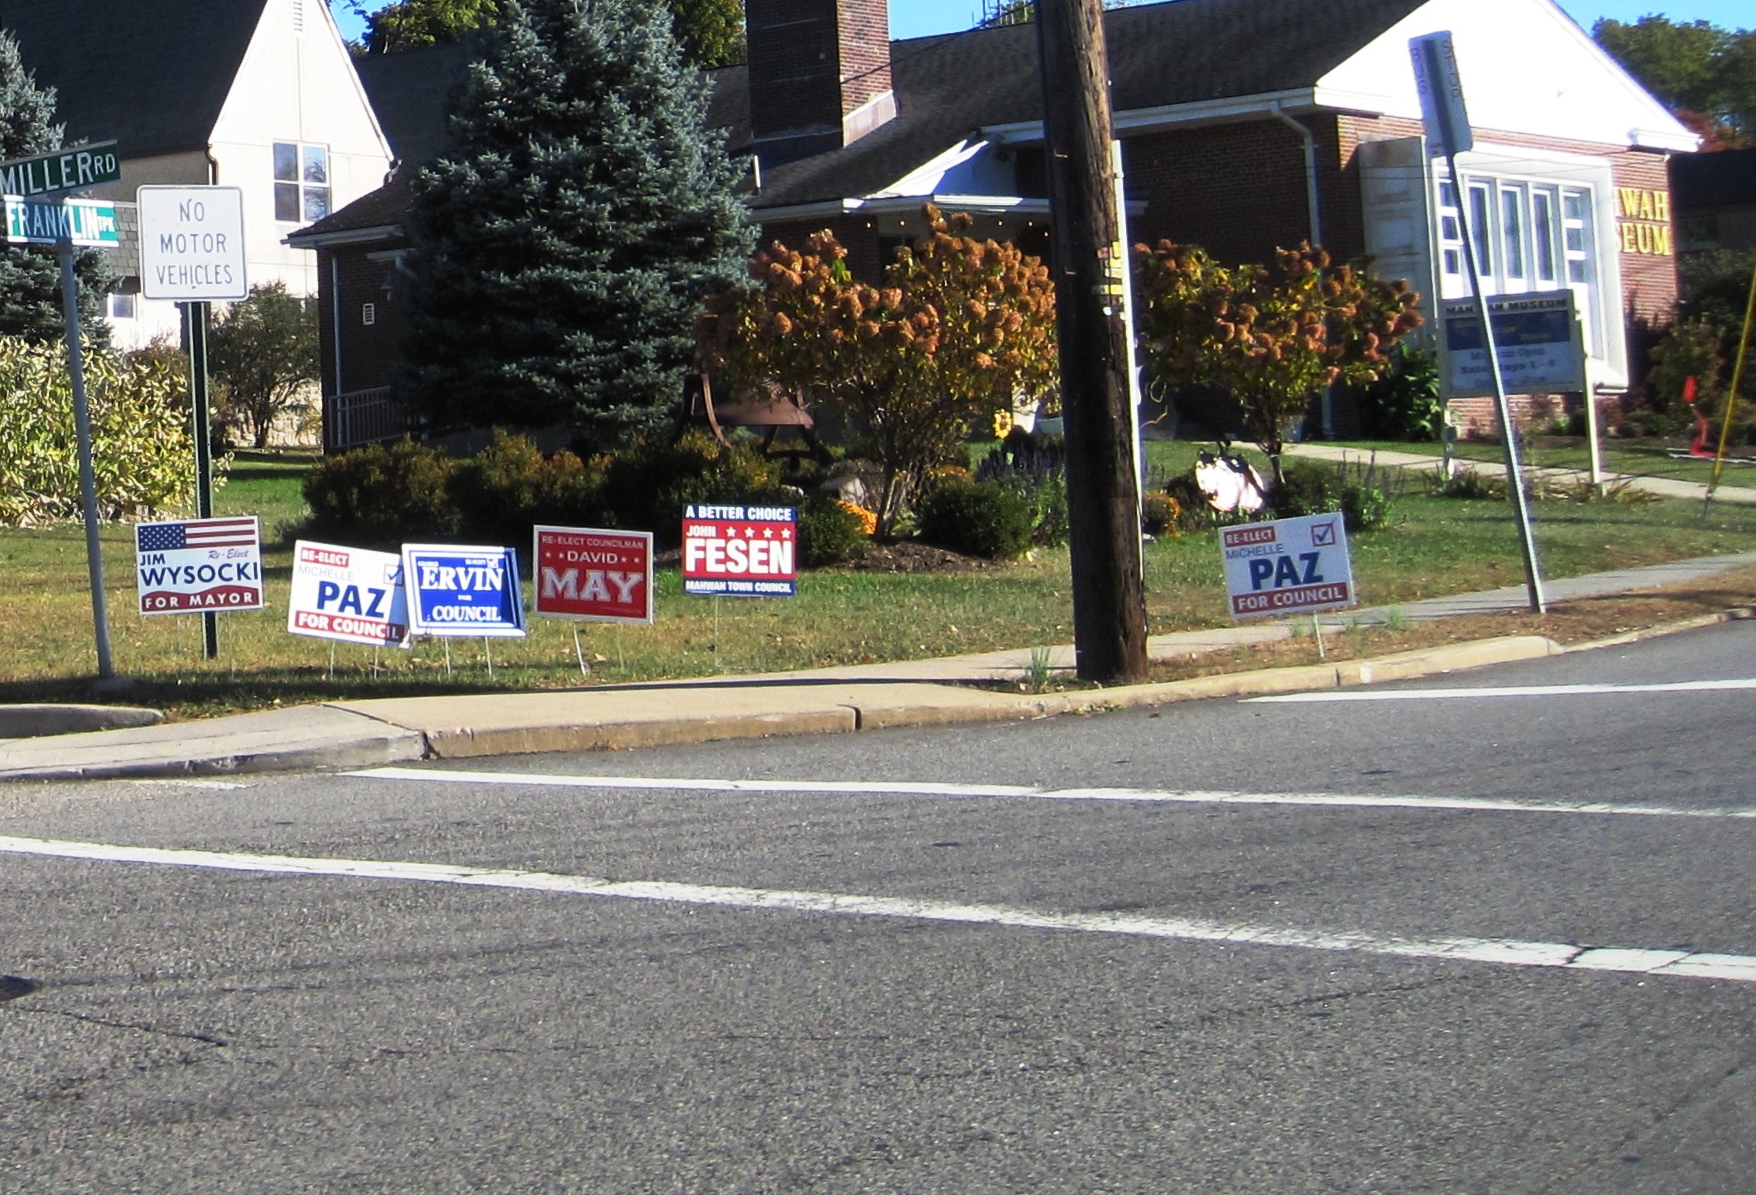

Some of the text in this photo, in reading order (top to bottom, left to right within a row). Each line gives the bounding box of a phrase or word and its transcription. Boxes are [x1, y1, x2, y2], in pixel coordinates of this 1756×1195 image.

[1443, 40, 1460, 99] STOP
[94, 154, 116, 175] RD
[179, 199, 204, 221] NO
[5, 202, 115, 239] FRANKLIN TPK
[160, 233, 226, 253] MOTOR
[156, 265, 232, 285] VEHICLES
[1446, 299, 1566, 314] MAHAH MUSEUM
[686, 505, 792, 521] A BETTER CHOICE
[686, 525, 716, 537] JOHN
[1226, 529, 1272, 544] RE-ELECT
[541, 535, 644, 549] RE-ELECT COUNCILMAN
[1226, 543, 1284, 559] MICHELLE
[140, 553, 165, 566] JIM
[301, 549, 348, 566] RE-ELECT
[567, 551, 618, 564] DAVID
[686, 538, 792, 574] FESEN
[140, 562, 258, 586] WYSOCKI
[298, 565, 354, 581] MICHELLE
[420, 567, 504, 591] ERVIN
[1249, 551, 1323, 591] PAZ
[541, 566, 644, 604] MAY
[727, 582, 753, 592] TOWN
[755, 582, 792, 593] COUNCIL
[145, 592, 253, 608] FOR MAYOR
[317, 581, 386, 618] PAZ
[1238, 587, 1343, 610] FOR COUNCIL
[432, 606, 501, 621] COUNCIL
[299, 613, 399, 639] FOR COUNCIL
